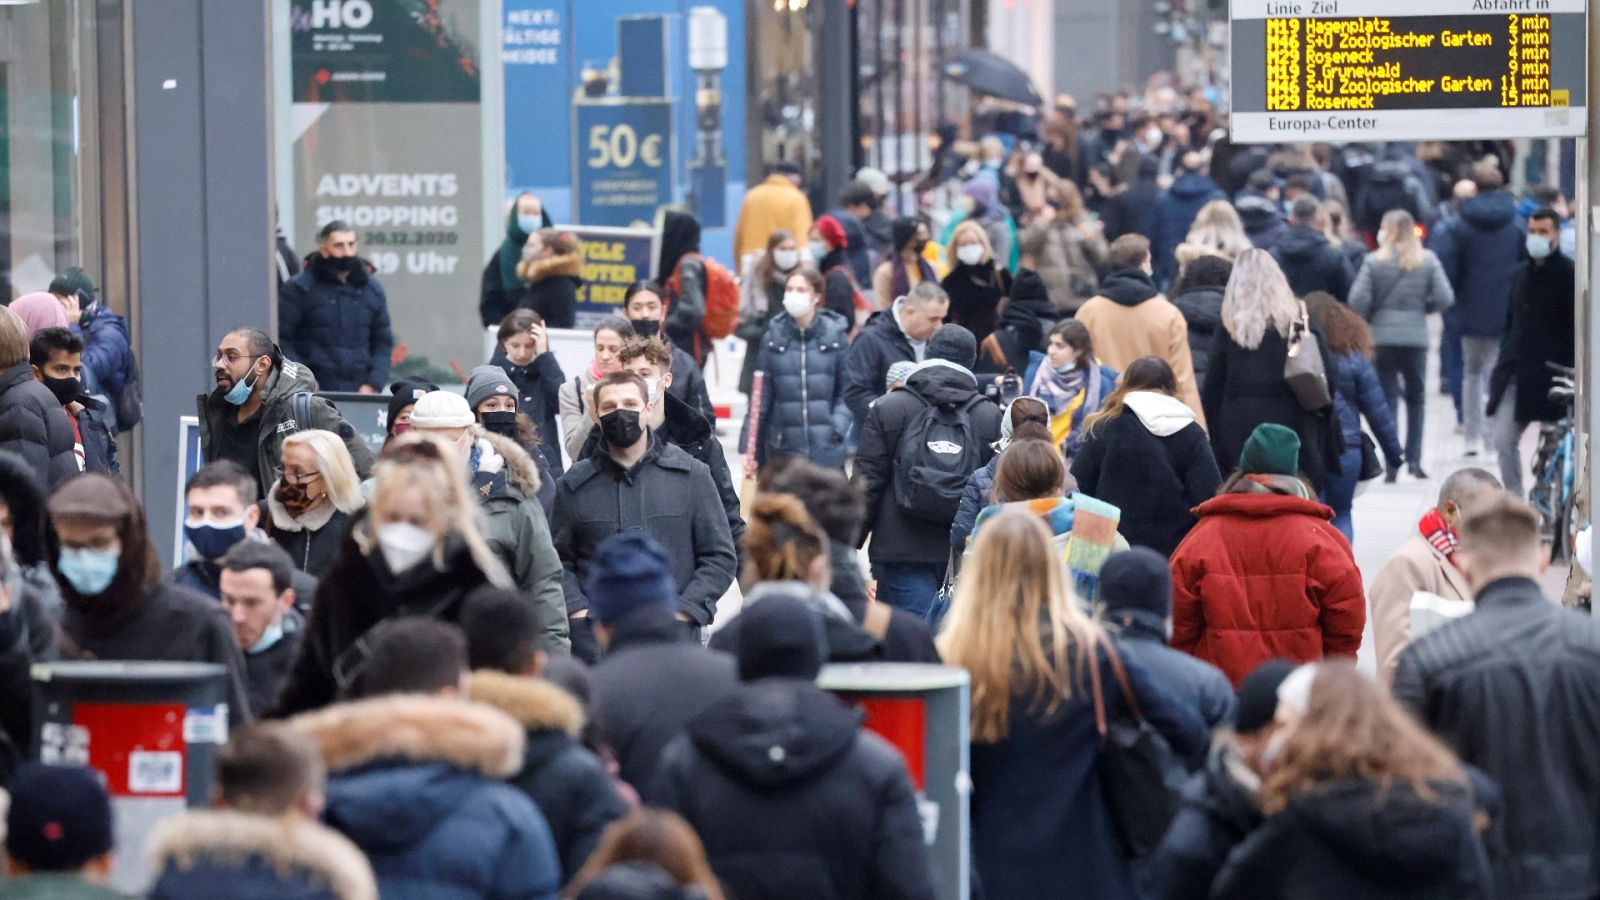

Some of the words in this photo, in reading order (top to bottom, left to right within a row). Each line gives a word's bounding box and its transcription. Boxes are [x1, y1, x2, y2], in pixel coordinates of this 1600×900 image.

[313, 0, 373, 29] HO
[1267, 2, 1302, 15] Linie
[1311, 1, 1338, 14] Ziel
[1473, 0, 1530, 10] Abfahrt
[1536, 0, 1549, 9] in
[1266, 18, 1300, 35] M19
[1305, 17, 1390, 35] Hagenplatz
[1508, 14, 1519, 29] 2
[1522, 14, 1549, 30] min
[1266, 34, 1300, 49] M46
[1340, 31, 1435, 50] Zoologischer
[1441, 30, 1493, 47] Garten
[1522, 29, 1549, 45] min
[1266, 49, 1300, 65] M29
[1305, 46, 1374, 64] Roseneck
[1508, 45, 1519, 60] 4
[1522, 45, 1549, 60] min
[1266, 64, 1300, 80] M19
[1305, 64, 1316, 79] S
[1322, 62, 1401, 79] Grunewald
[1508, 60, 1519, 74] 9
[1522, 60, 1549, 75] min
[1266, 79, 1300, 95] M46
[1305, 79, 1334, 94] S+U
[1340, 76, 1435, 95] Zoologischer
[1441, 75, 1493, 92] Garten
[1501, 74, 1517, 91] 11
[1522, 75, 1549, 90] min
[1266, 94, 1300, 110] M29
[1305, 93, 1374, 110] Roseneck
[1501, 90, 1519, 106] 15
[1522, 90, 1549, 106] min
[1269, 116, 1377, 133] Europa-Center
[316, 173, 458, 197] ADVENTS
[315, 205, 459, 227] SHOPPING
[406, 251, 459, 274] Uhr
